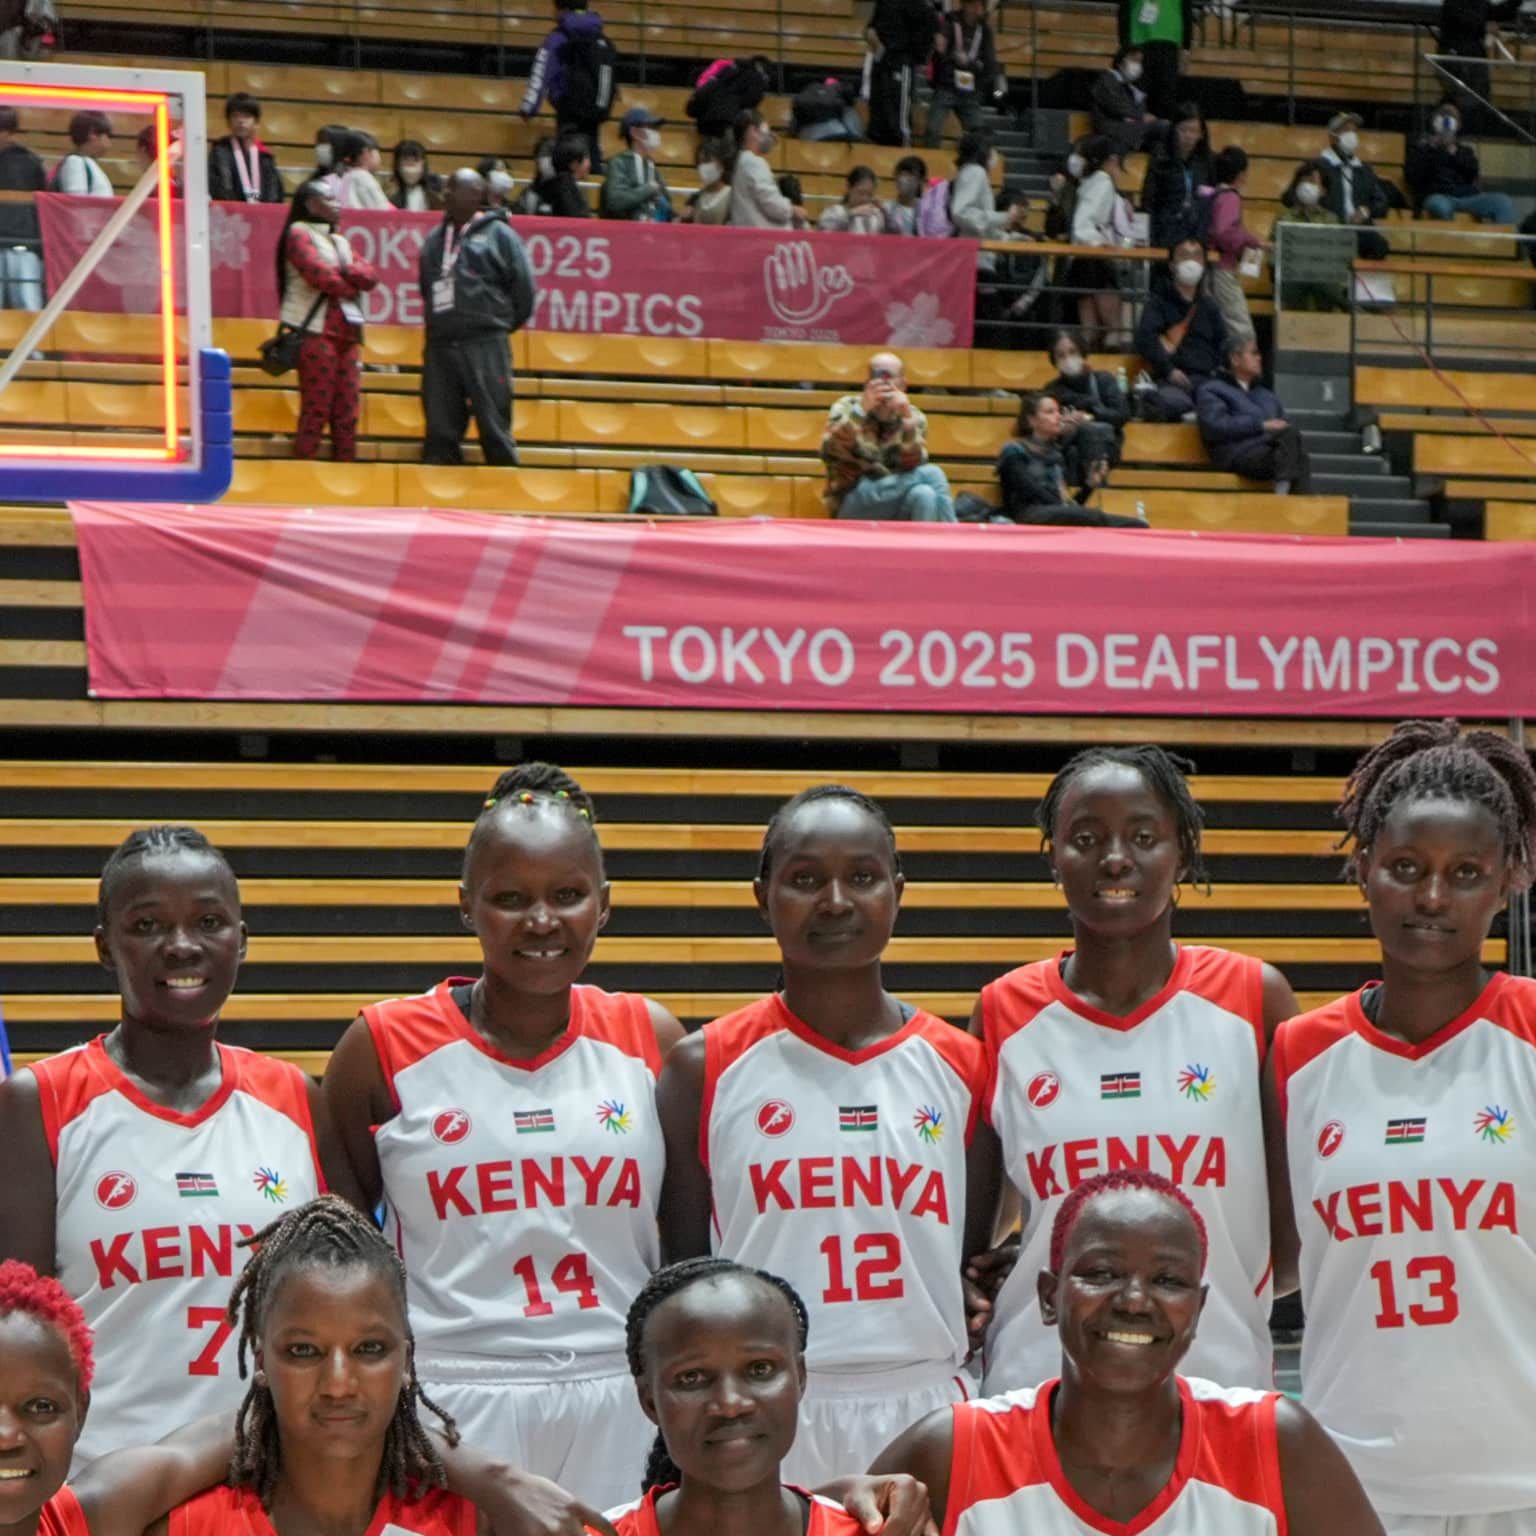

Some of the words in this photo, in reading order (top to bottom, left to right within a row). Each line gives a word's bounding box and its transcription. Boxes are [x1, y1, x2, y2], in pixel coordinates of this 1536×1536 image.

[527, 233, 612, 279] 025
[621, 624, 855, 687] TOKYO
[878, 629, 1037, 691] 2025
[1056, 632, 1500, 696] DEAFLYMPICS
[426, 1155, 642, 1221] KENYA
[748, 1155, 950, 1225] KENYA
[1025, 1134, 1226, 1201] KENYA
[1314, 1177, 1519, 1243] KENYA
[89, 1224, 261, 1290] KEN
[512, 1252, 600, 1317] 14
[819, 1231, 905, 1304] 12
[1370, 1254, 1460, 1329] 13
[187, 1306, 235, 1376] 7
